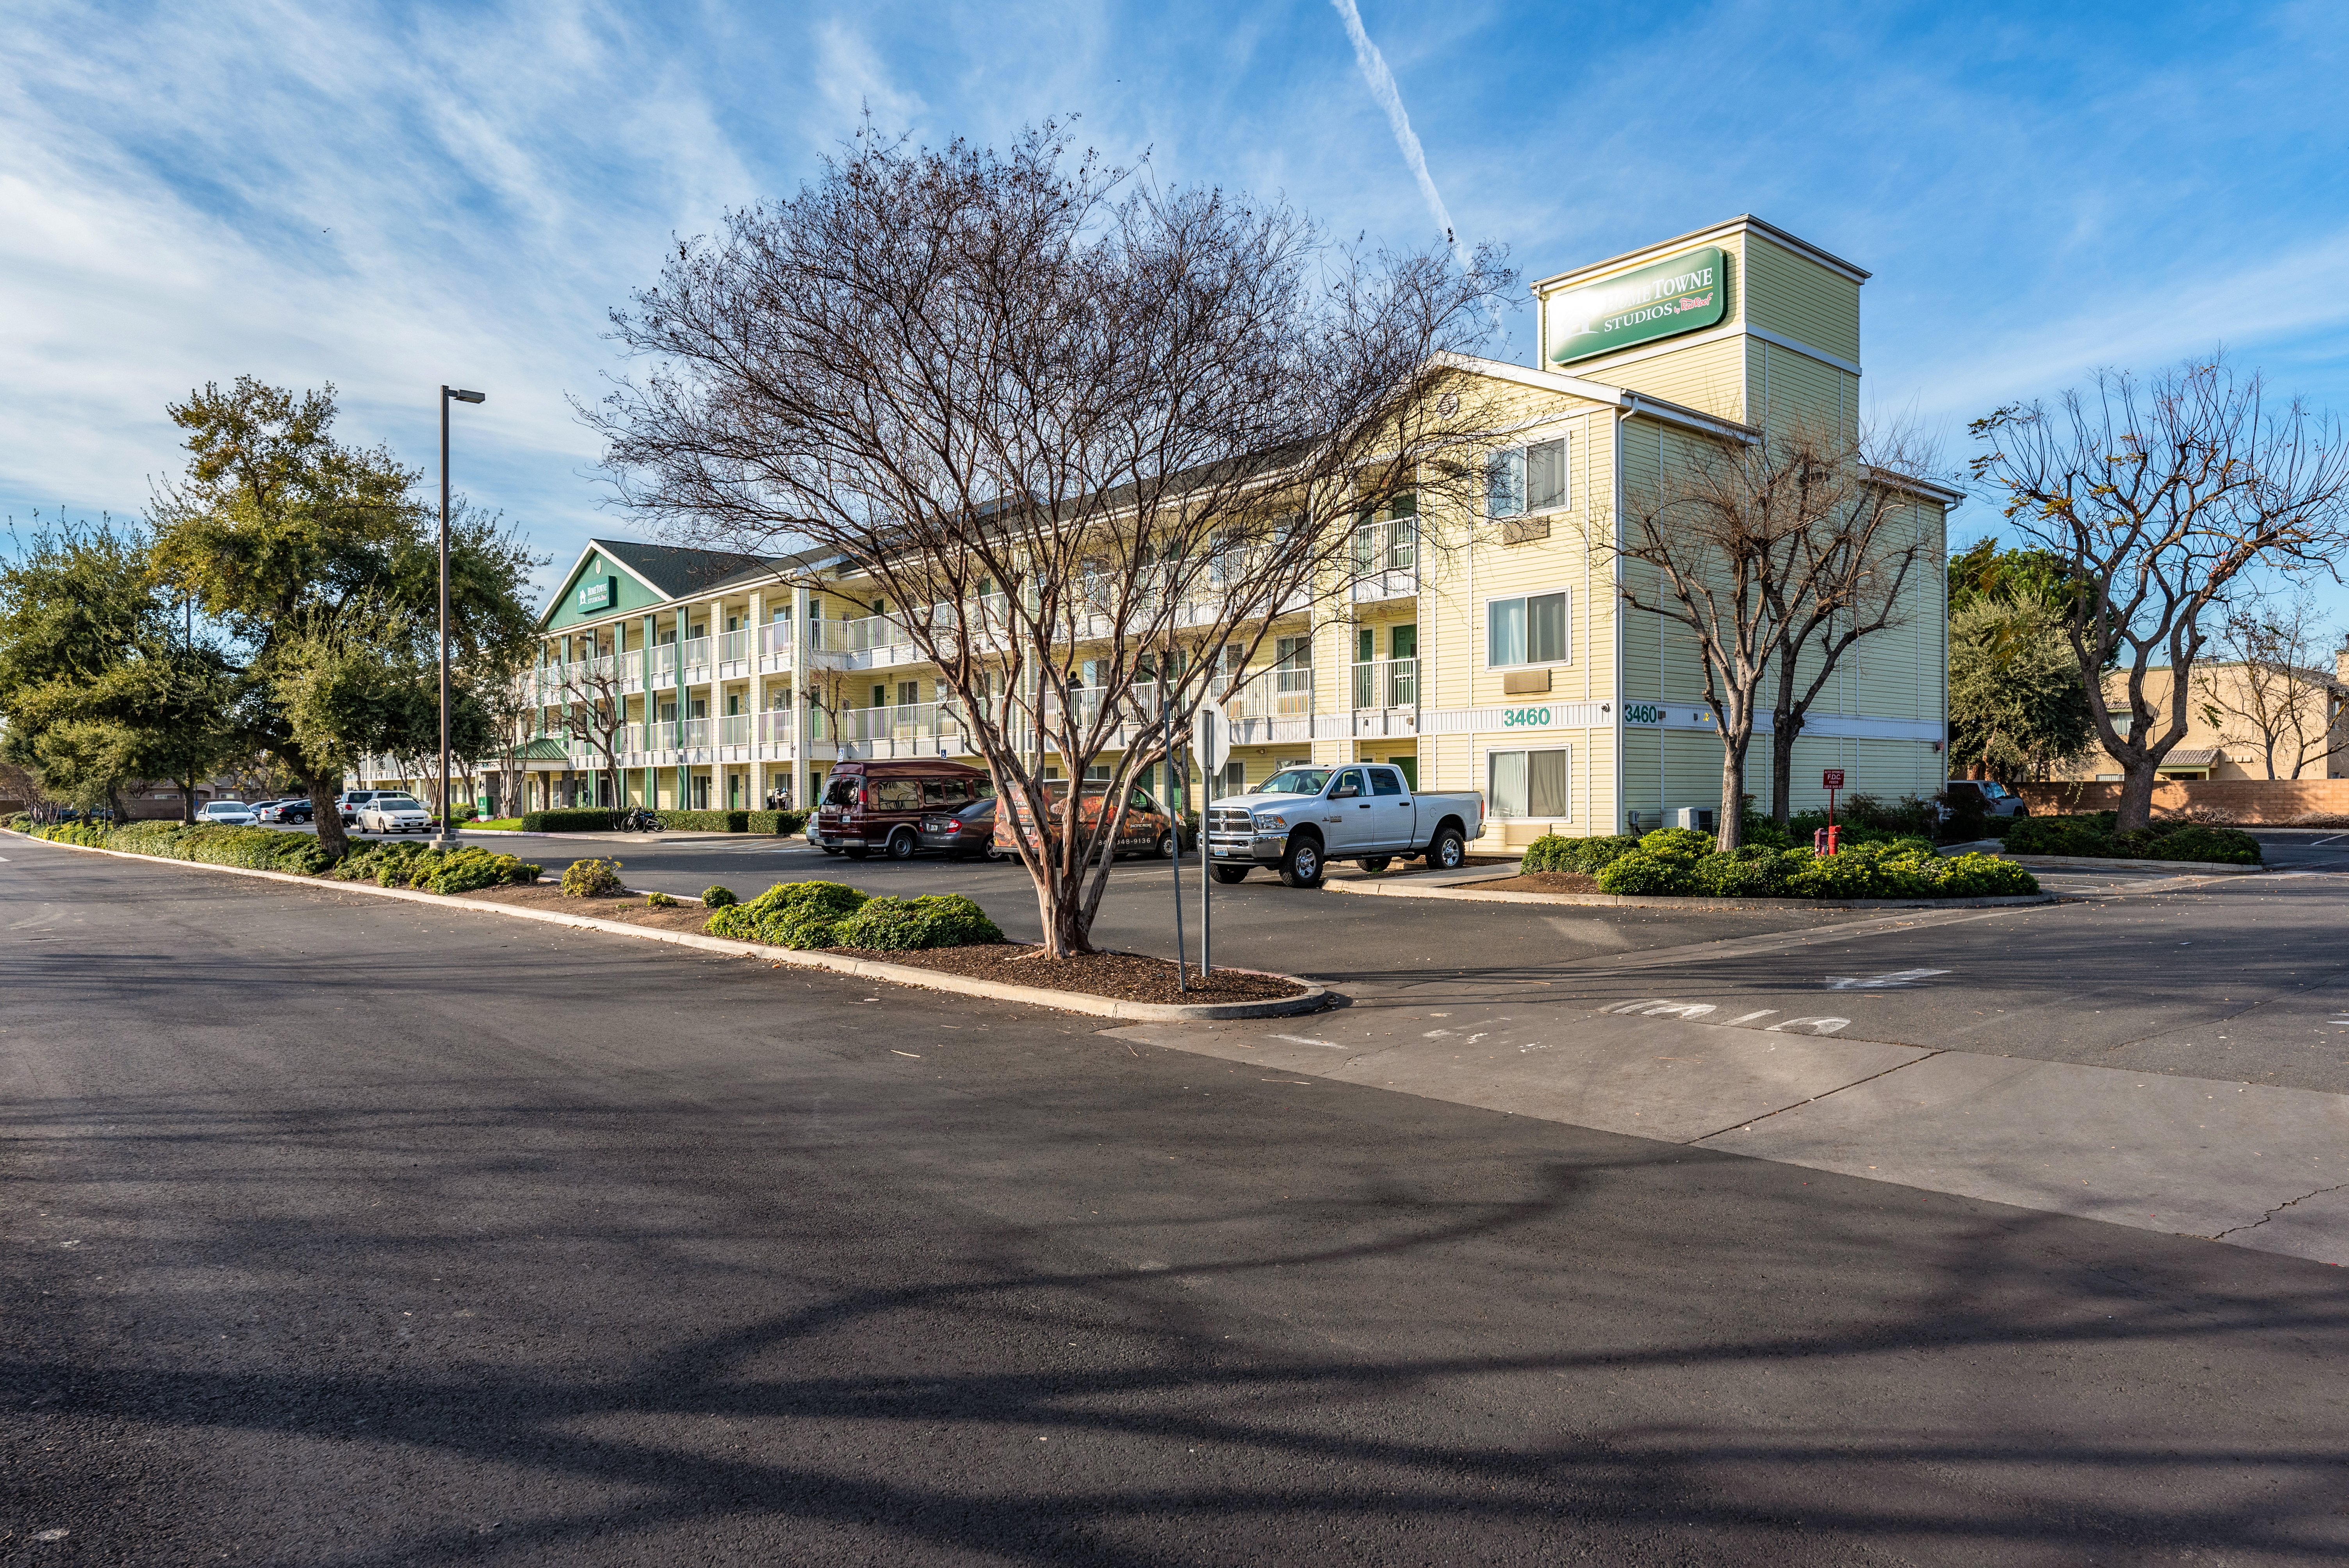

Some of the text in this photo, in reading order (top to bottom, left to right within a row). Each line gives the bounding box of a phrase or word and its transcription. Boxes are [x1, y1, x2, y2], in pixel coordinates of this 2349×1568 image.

[1604, 303, 1672, 332] STUDIOS
[588, 596, 601, 604] STUDIOS
[1504, 708, 1550, 726] 3460
[1625, 705, 1657, 723] 3460
